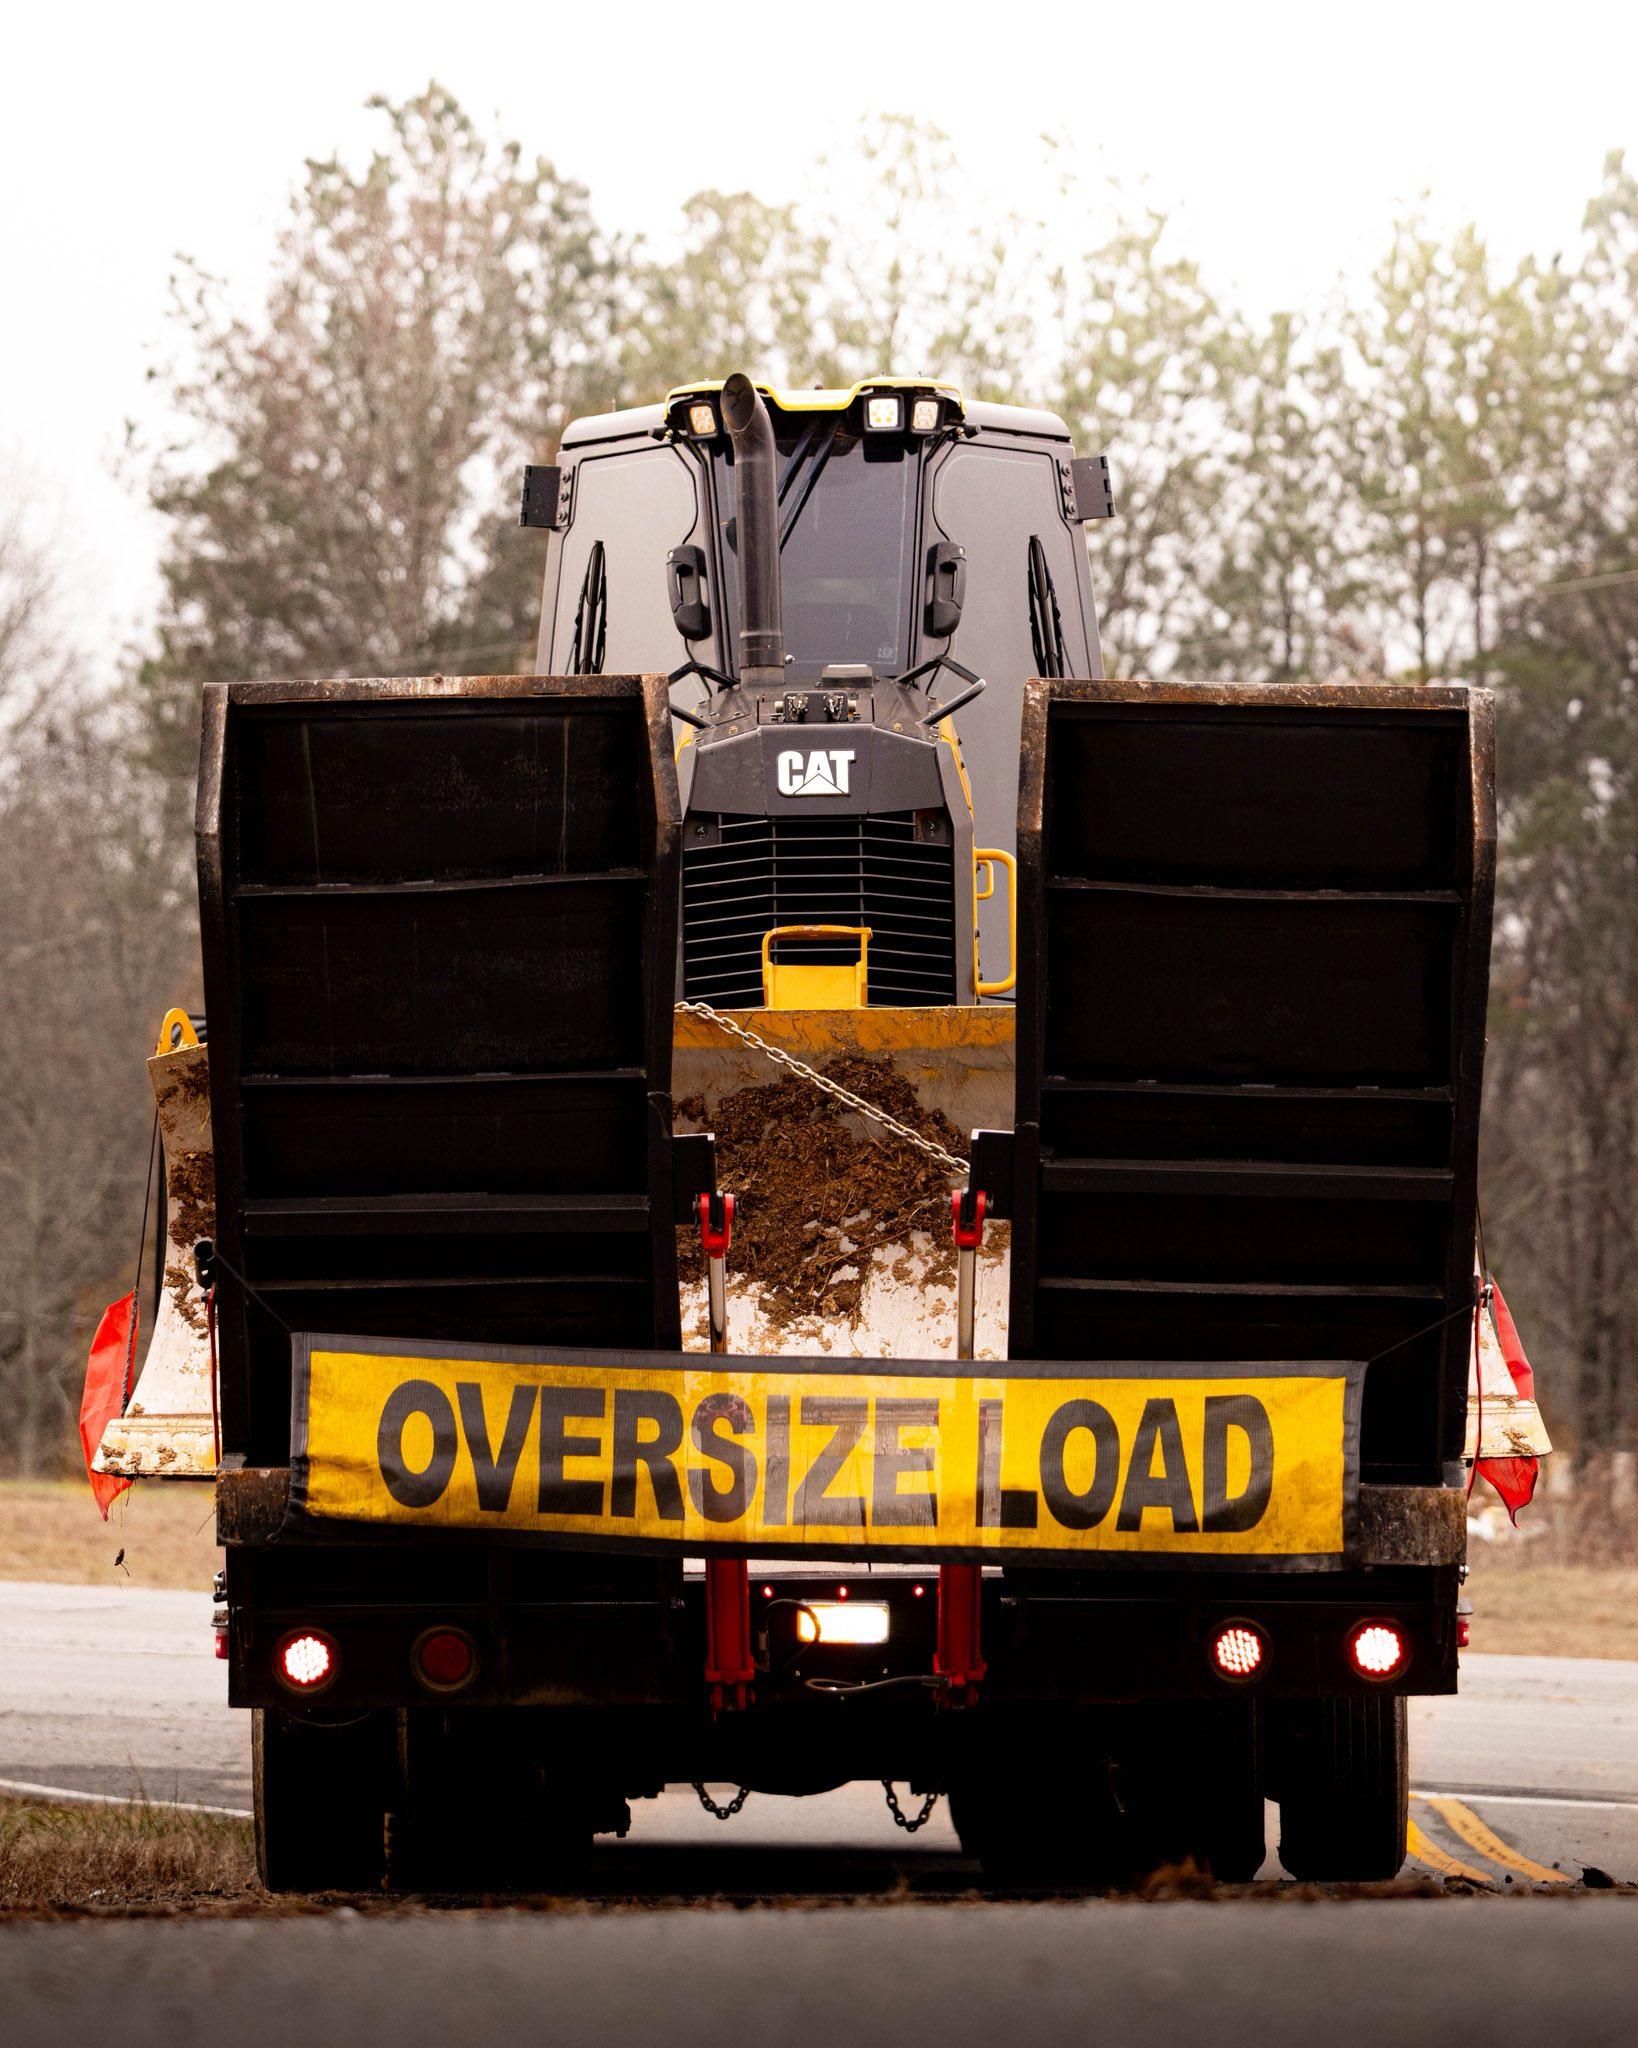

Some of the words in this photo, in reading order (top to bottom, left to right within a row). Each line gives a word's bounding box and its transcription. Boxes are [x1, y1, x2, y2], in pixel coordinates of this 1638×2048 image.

[777, 750, 855, 795] CAT
[376, 1379, 940, 1527] OVERSIZE
[975, 1394, 1275, 1533] LOAD
